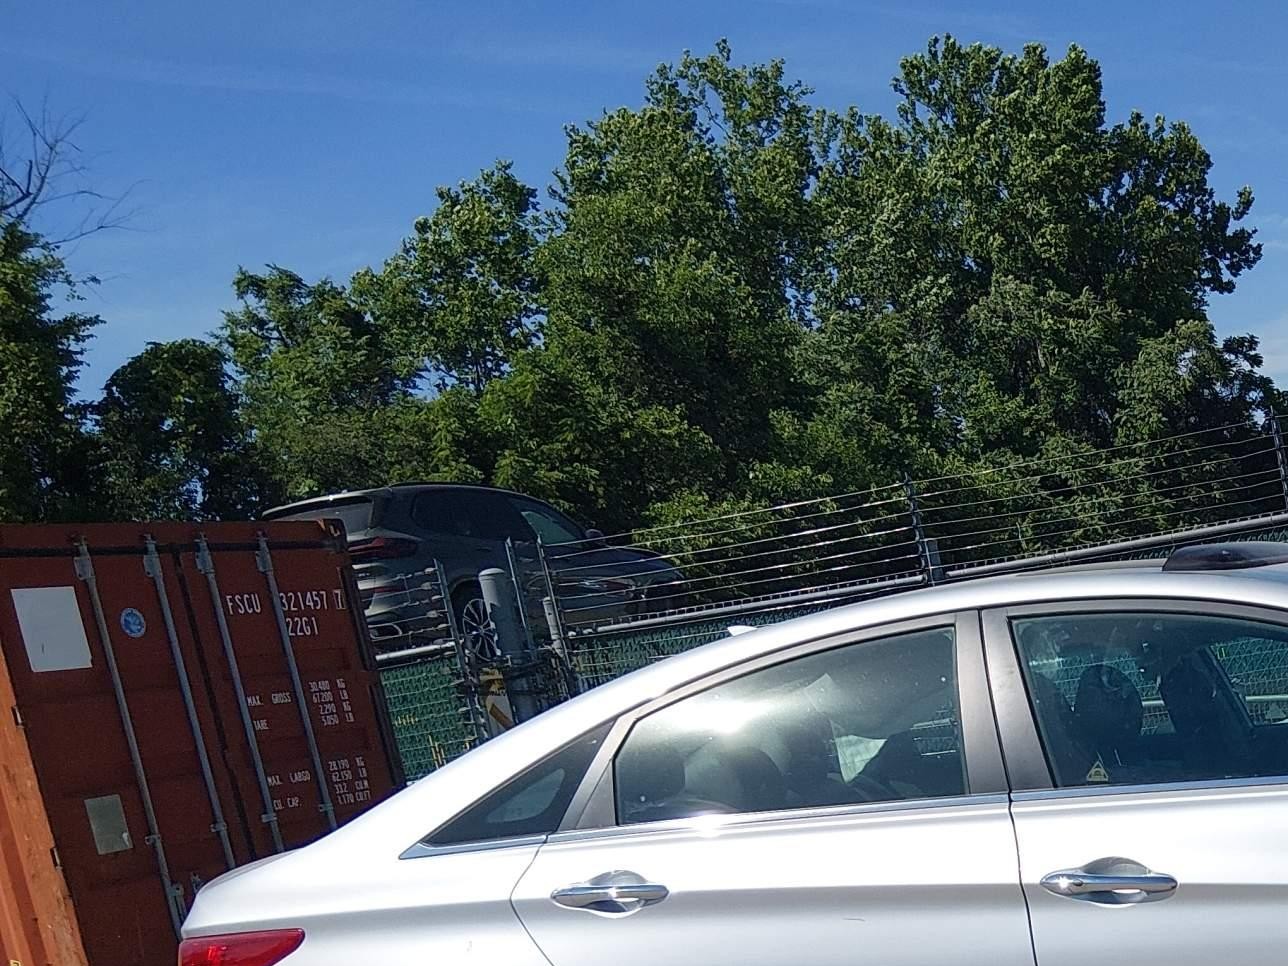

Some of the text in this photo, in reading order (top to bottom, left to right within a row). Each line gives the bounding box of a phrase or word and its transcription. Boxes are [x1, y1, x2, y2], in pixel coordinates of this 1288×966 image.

[226, 593, 261, 615] FSCU
[280, 590, 328, 611] 321457
[286, 617, 319, 636] 22G1
[336, 678, 346, 689] KG
[247, 692, 291, 706] MAX. GROSS
[340, 689, 349, 700] LB
[343, 701, 352, 712] KG
[345, 712, 355, 723] LB
[355, 756, 365, 767] KG
[359, 767, 367, 778] LB
